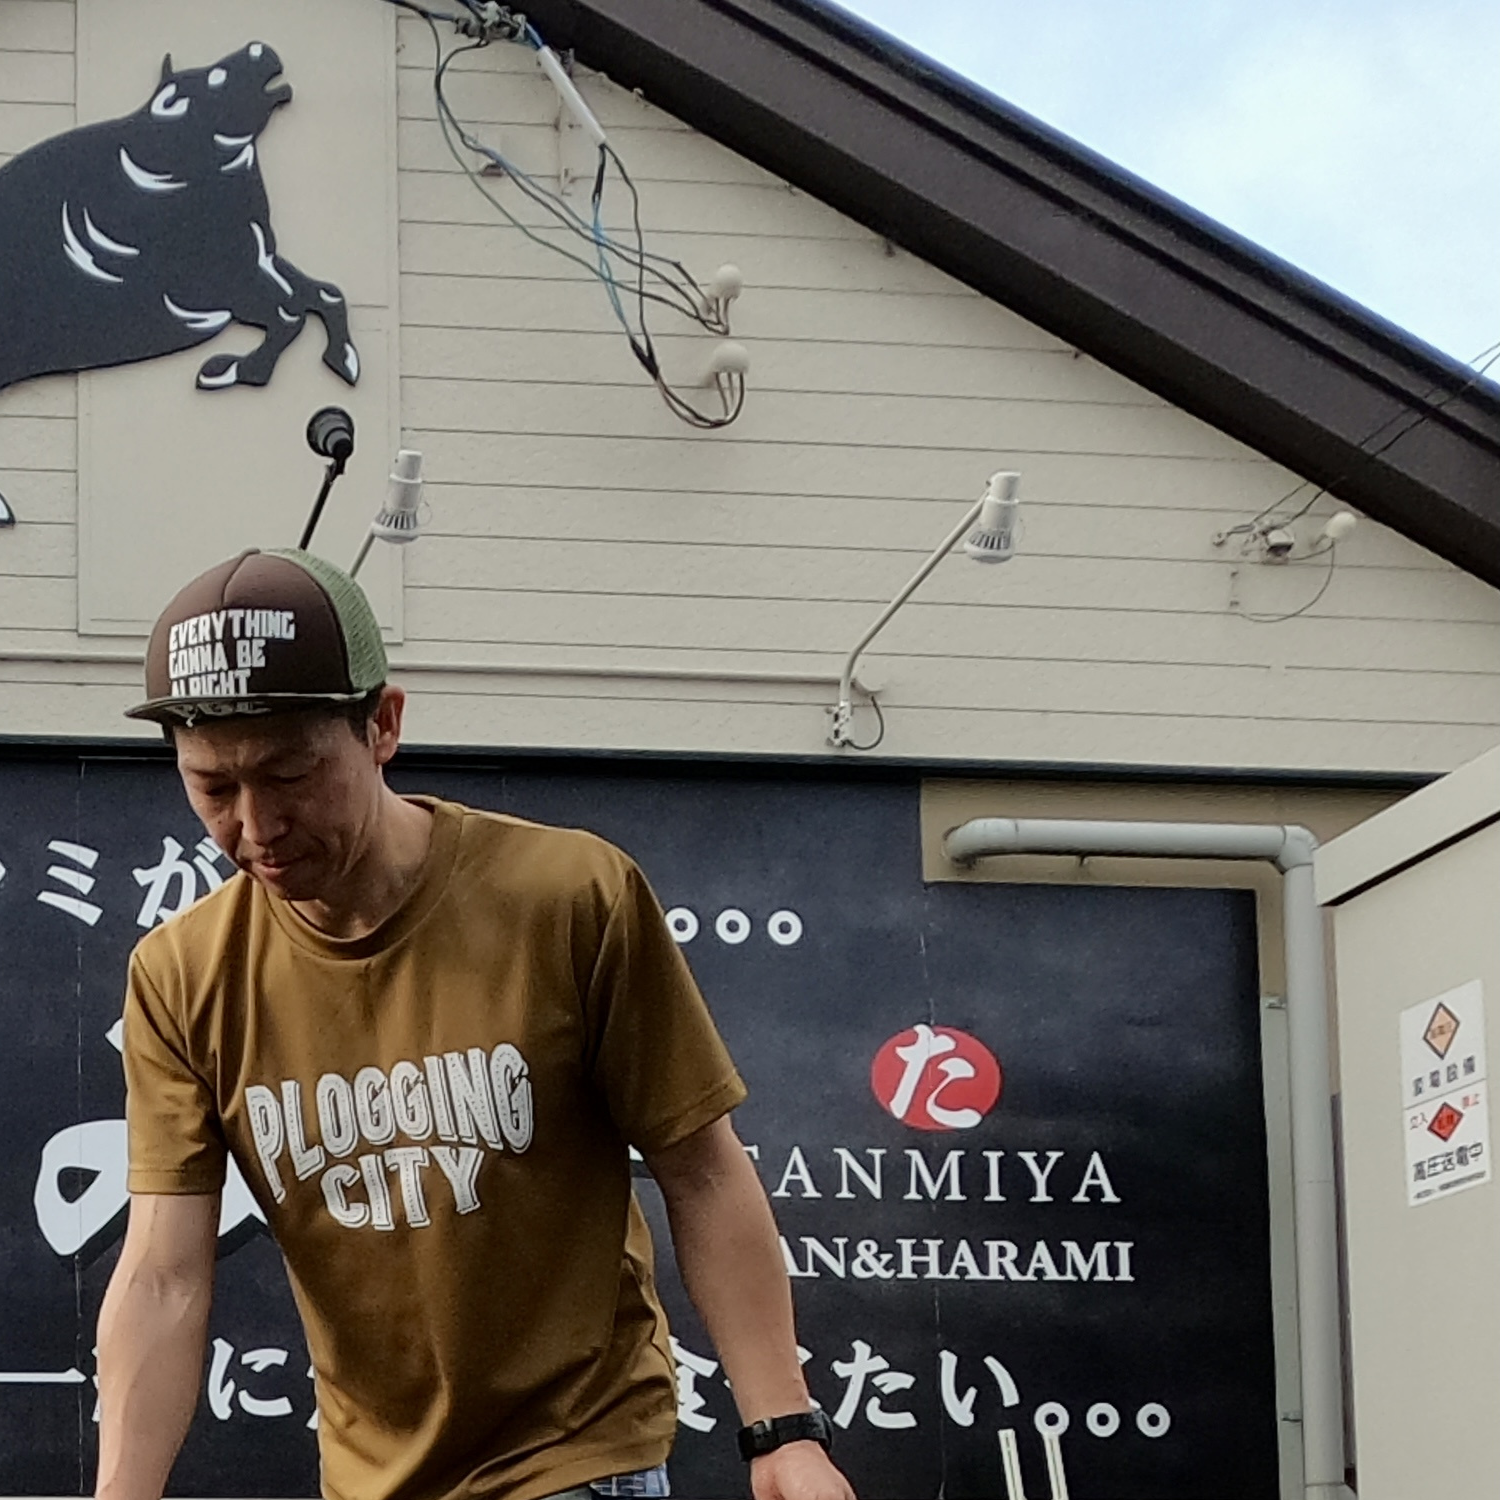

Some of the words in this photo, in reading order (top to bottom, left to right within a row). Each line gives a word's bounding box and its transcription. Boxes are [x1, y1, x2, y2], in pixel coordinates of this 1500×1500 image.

[169, 609, 295, 652] EVERYTHING
[169, 641, 229, 680] GONNA
[236, 639, 266, 668] BE
[890, 1023, 982, 1129] た
[245, 1042, 534, 1205] PLOGGING
[320, 1146, 485, 1231] CITY
[743, 1145, 1122, 1203] ANMIYA
